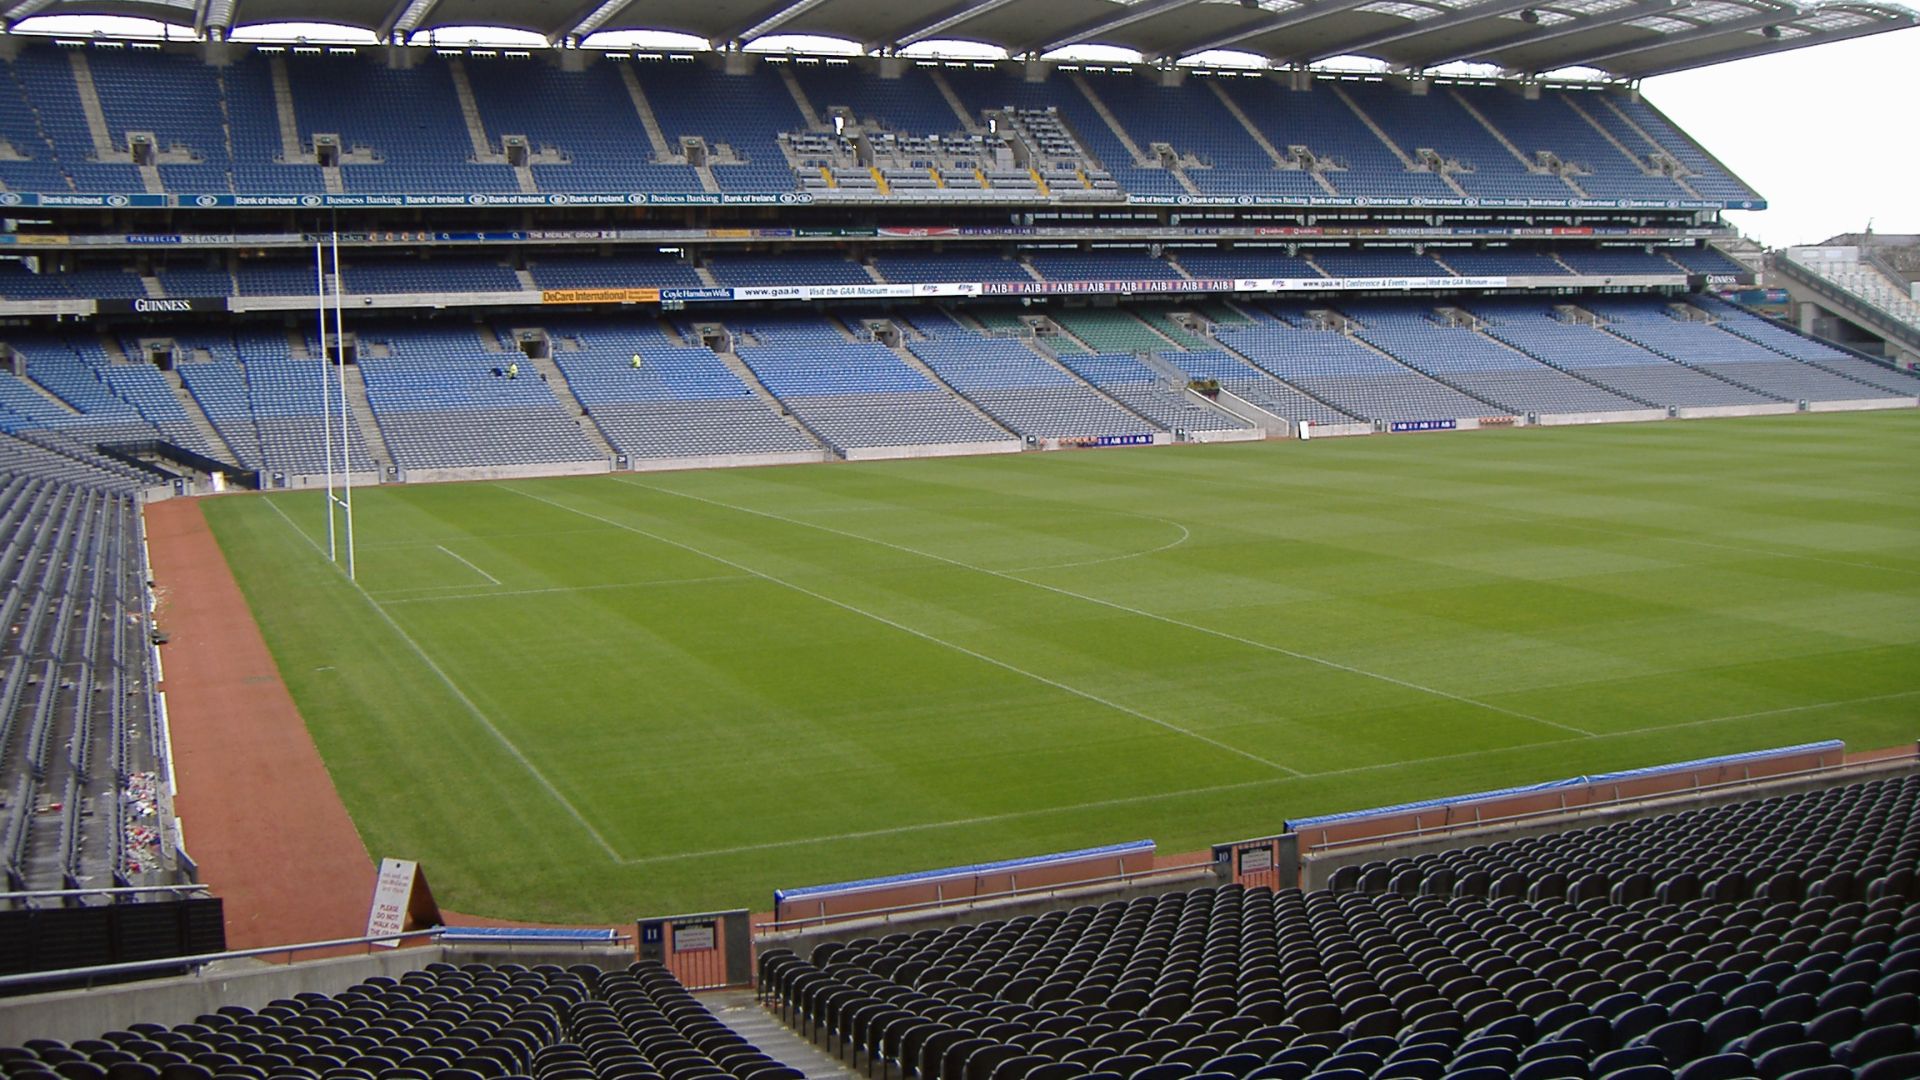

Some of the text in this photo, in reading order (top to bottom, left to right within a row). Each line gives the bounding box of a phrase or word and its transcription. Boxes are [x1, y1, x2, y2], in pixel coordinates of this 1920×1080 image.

[42, 196, 62, 205] Bank
[73, 196, 102, 205] Ireland
[326, 196, 402, 205] Business Banking
[489, 195, 545, 203] Bank of Ireland
[651, 194, 719, 204] Business Banking
[1256, 196, 1308, 205] Business Banking
[130, 235, 177, 243] PATRICIA
[1387, 279, 1408, 287] Events
[1706, 274, 1736, 284] GUINNESS
[990, 284, 1007, 293] AIB
[1024, 283, 1041, 293] AIB
[1057, 283, 1073, 292] AIB
[1087, 282, 1104, 292] AIB
[1120, 282, 1137, 291] AIB
[1151, 282, 1167, 291] AIB
[1181, 281, 1198, 290] AIB
[1212, 281, 1229, 290] AIB
[662, 289, 682, 299] Coyle
[683, 289, 712, 297] Hamilton
[712, 289, 730, 297] Willis
[745, 287, 800, 296] www.gaa.ie
[826, 287, 838, 295] the
[840, 287, 856, 295] GAA
[543, 291, 574, 302] DeCare
[575, 290, 624, 300] International
[135, 299, 192, 312] GUINNESS
[1219, 851, 1229, 862] 10
[647, 928, 657, 940] 11
